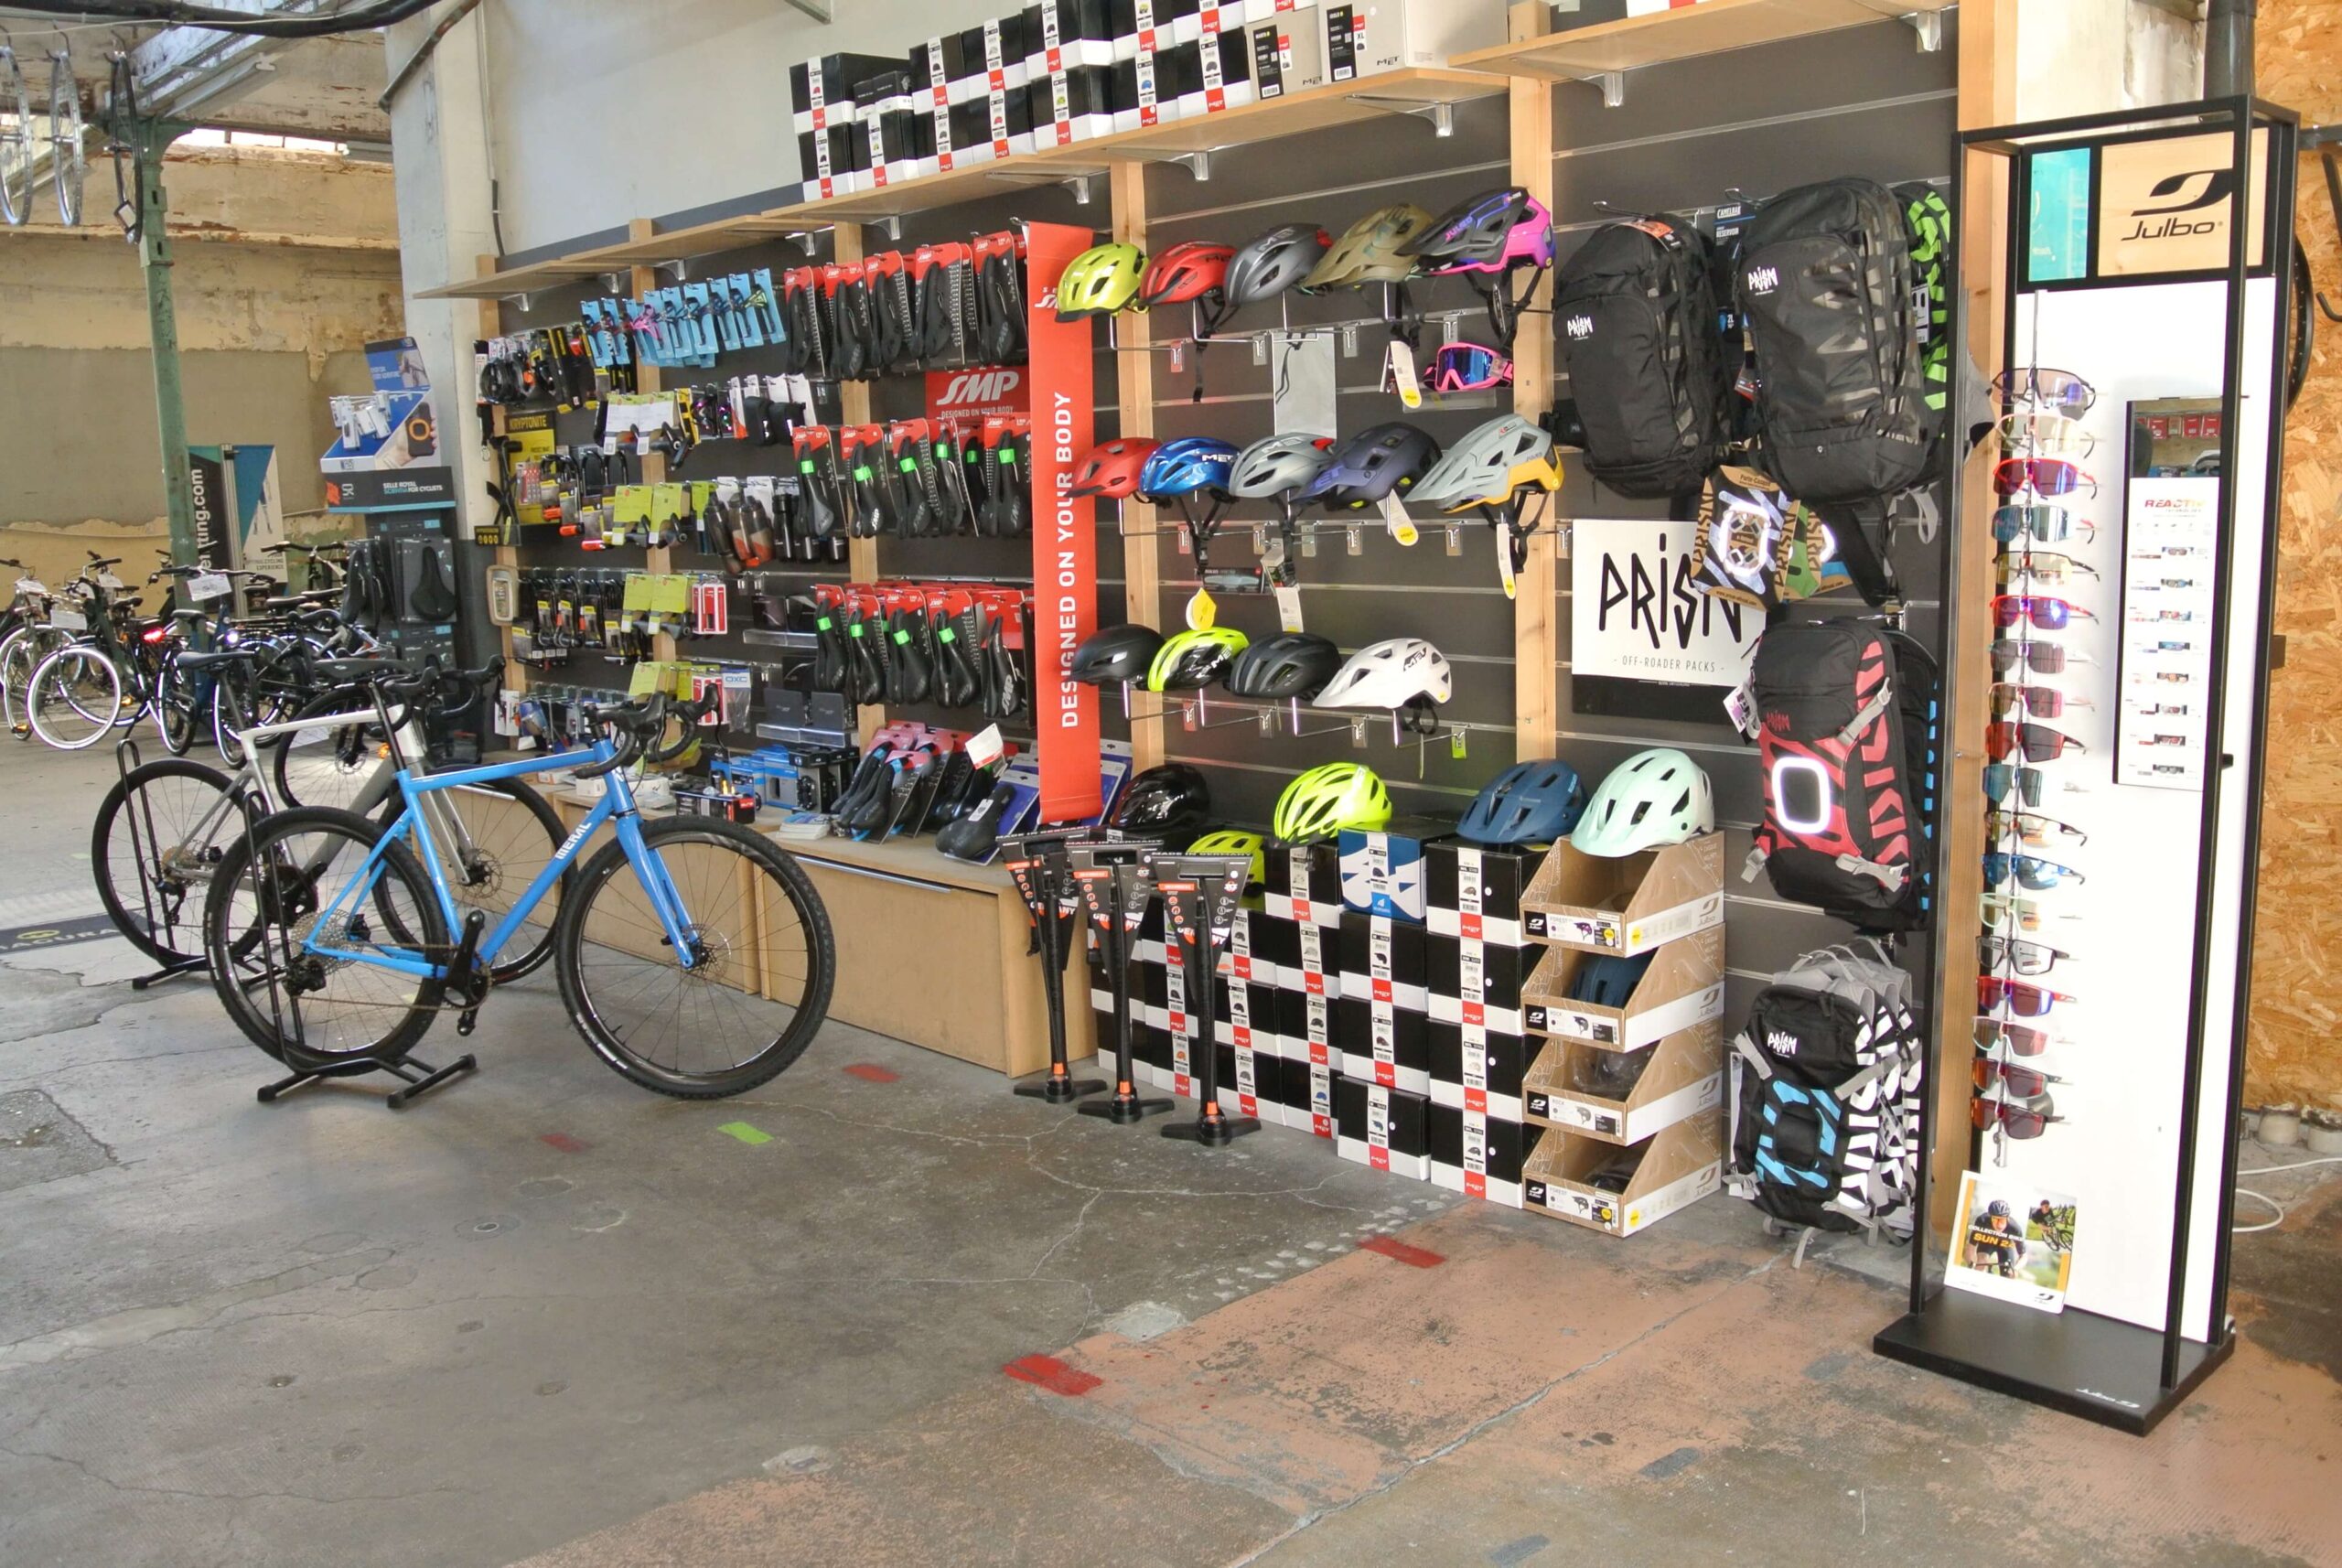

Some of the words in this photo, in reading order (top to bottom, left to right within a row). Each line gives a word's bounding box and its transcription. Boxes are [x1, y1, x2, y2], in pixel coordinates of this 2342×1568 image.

[936, 371, 1019, 406] SMP
[1054, 392, 1072, 462] BODY
[1056, 472, 1075, 548] YOUR
[1058, 551, 1076, 586] ON
[1060, 596, 1078, 728] DESIGNED
[1622, 655, 1681, 670] OFF-ROADER
[1686, 660, 1715, 672] PACKS
[1973, 1233, 1999, 1246] SUN
